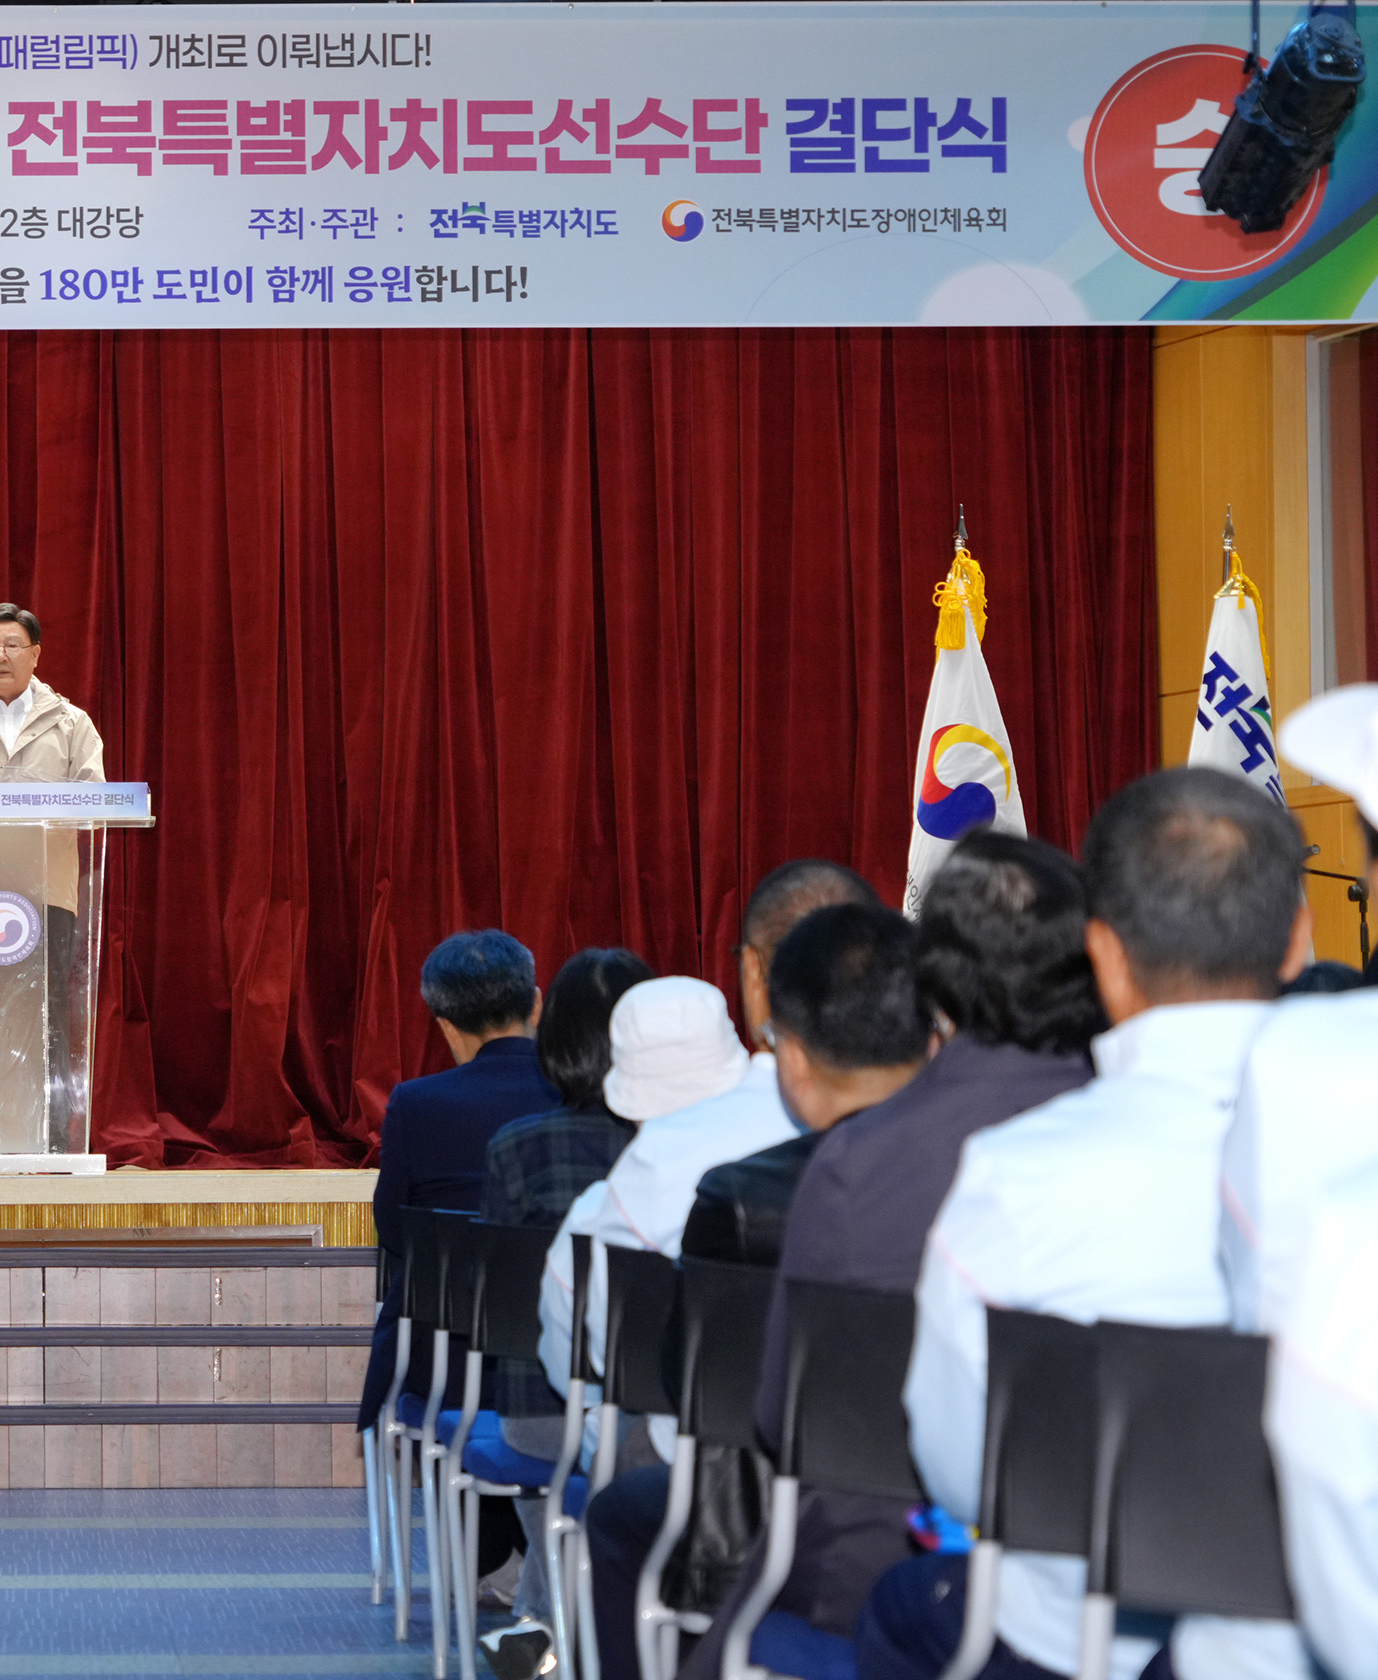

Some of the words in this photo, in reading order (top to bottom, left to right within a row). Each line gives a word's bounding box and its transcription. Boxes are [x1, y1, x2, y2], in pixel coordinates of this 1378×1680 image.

[149, 34, 248, 70] 개최로
[258, 33, 432, 69] 이뤄냅시다!
[8, 97, 769, 177] 전북특별자치도선수단
[786, 97, 1008, 174] 결단식
[58, 206, 144, 239] 대강당
[248, 207, 379, 241] 주최·주관
[430, 202, 619, 239] 전북특별자치도
[712, 207, 1007, 234] 전북특별자치도장애인체육회
[40, 267, 145, 304] 180만
[153, 266, 254, 304] 도민이
[266, 266, 334, 304] 함께
[344, 266, 528, 303] 응원합니다!
[1, 794, 102, 806] 전북특별자치도선수단
[104, 793, 134, 805] 결단식
[17, 898, 38, 931] ASSOCIATION
